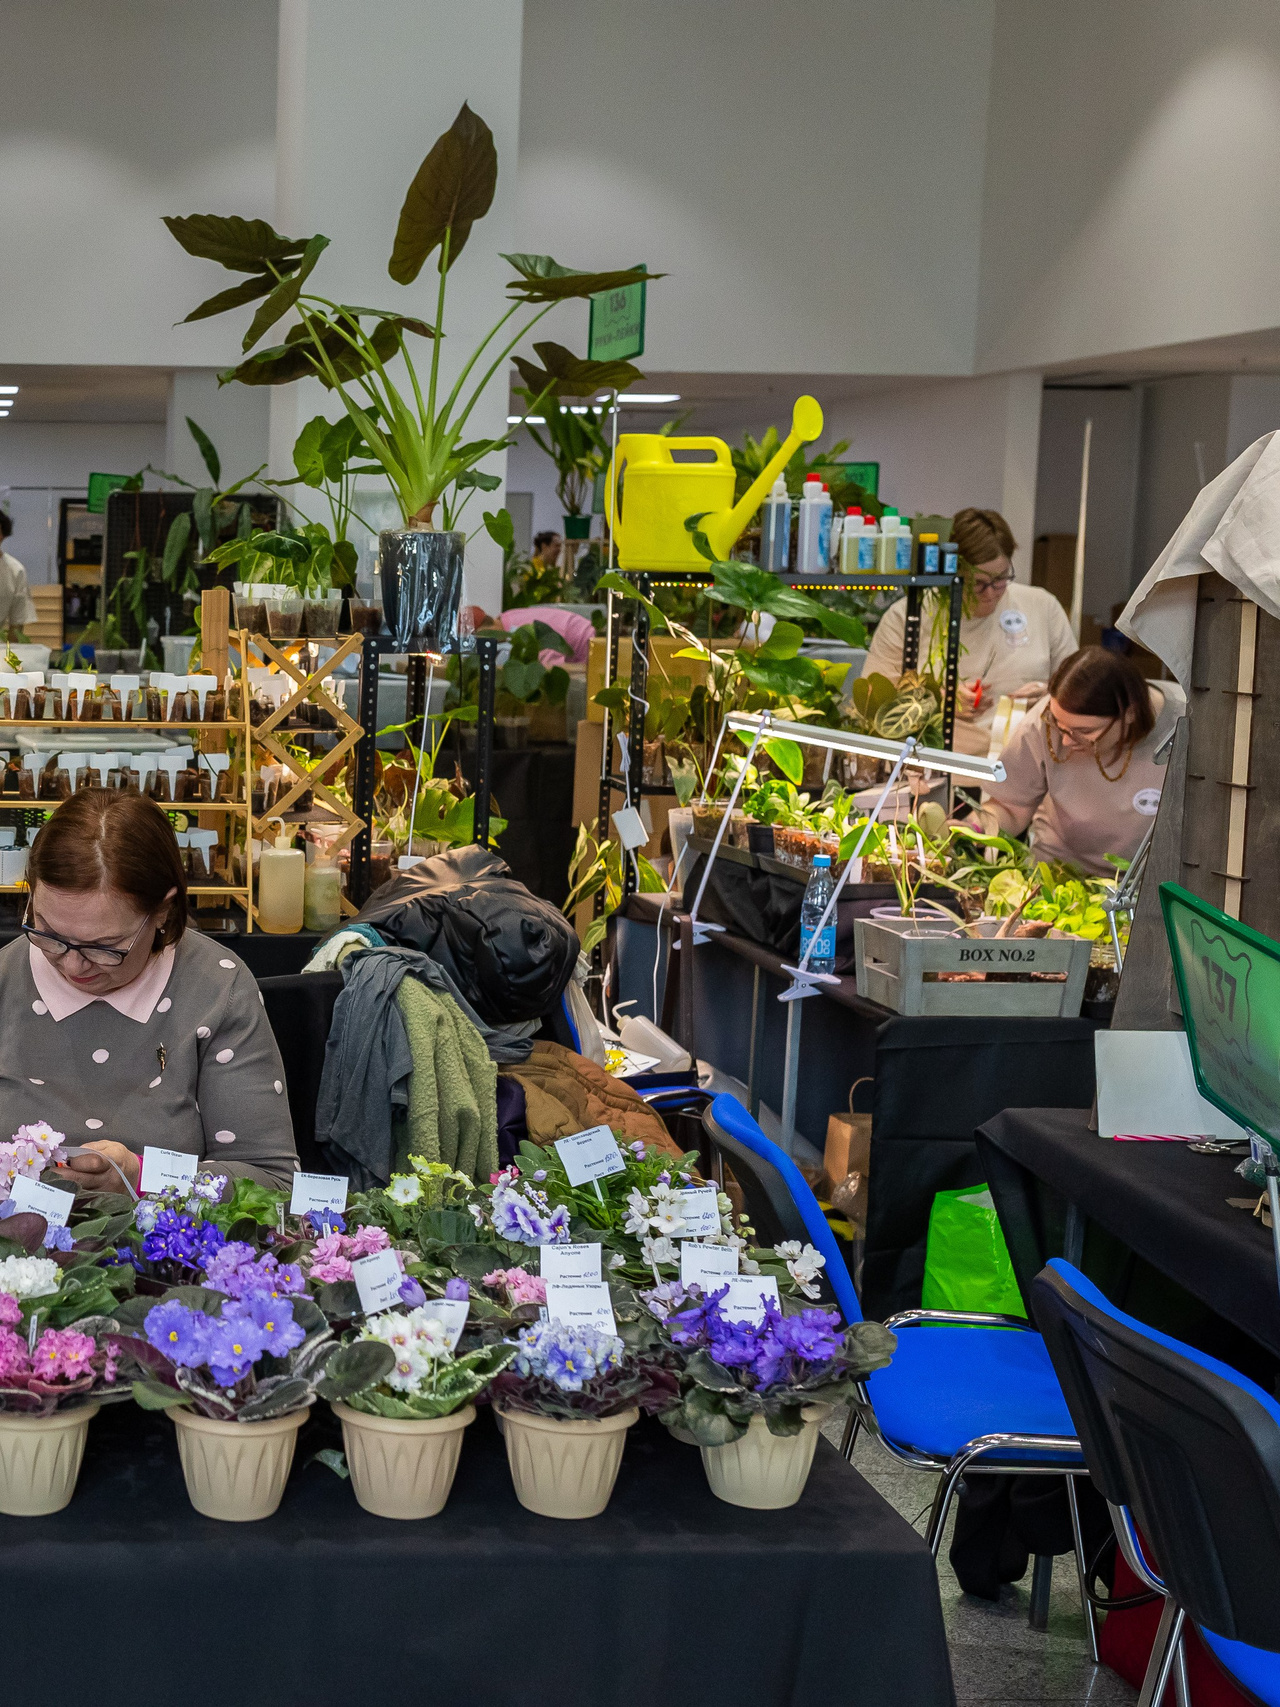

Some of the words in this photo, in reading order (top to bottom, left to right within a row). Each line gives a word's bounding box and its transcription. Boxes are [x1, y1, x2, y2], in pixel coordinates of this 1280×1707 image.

[959, 948, 995, 962] BOX
[998, 948, 1036, 962] NO.2
[1200, 956, 1238, 1022] 137
[584, 1158, 604, 1169] Растение
[160, 1172, 179, 1180] Растение
[307, 1196, 329, 1204] Растение
[27, 1203, 48, 1215] Растение
